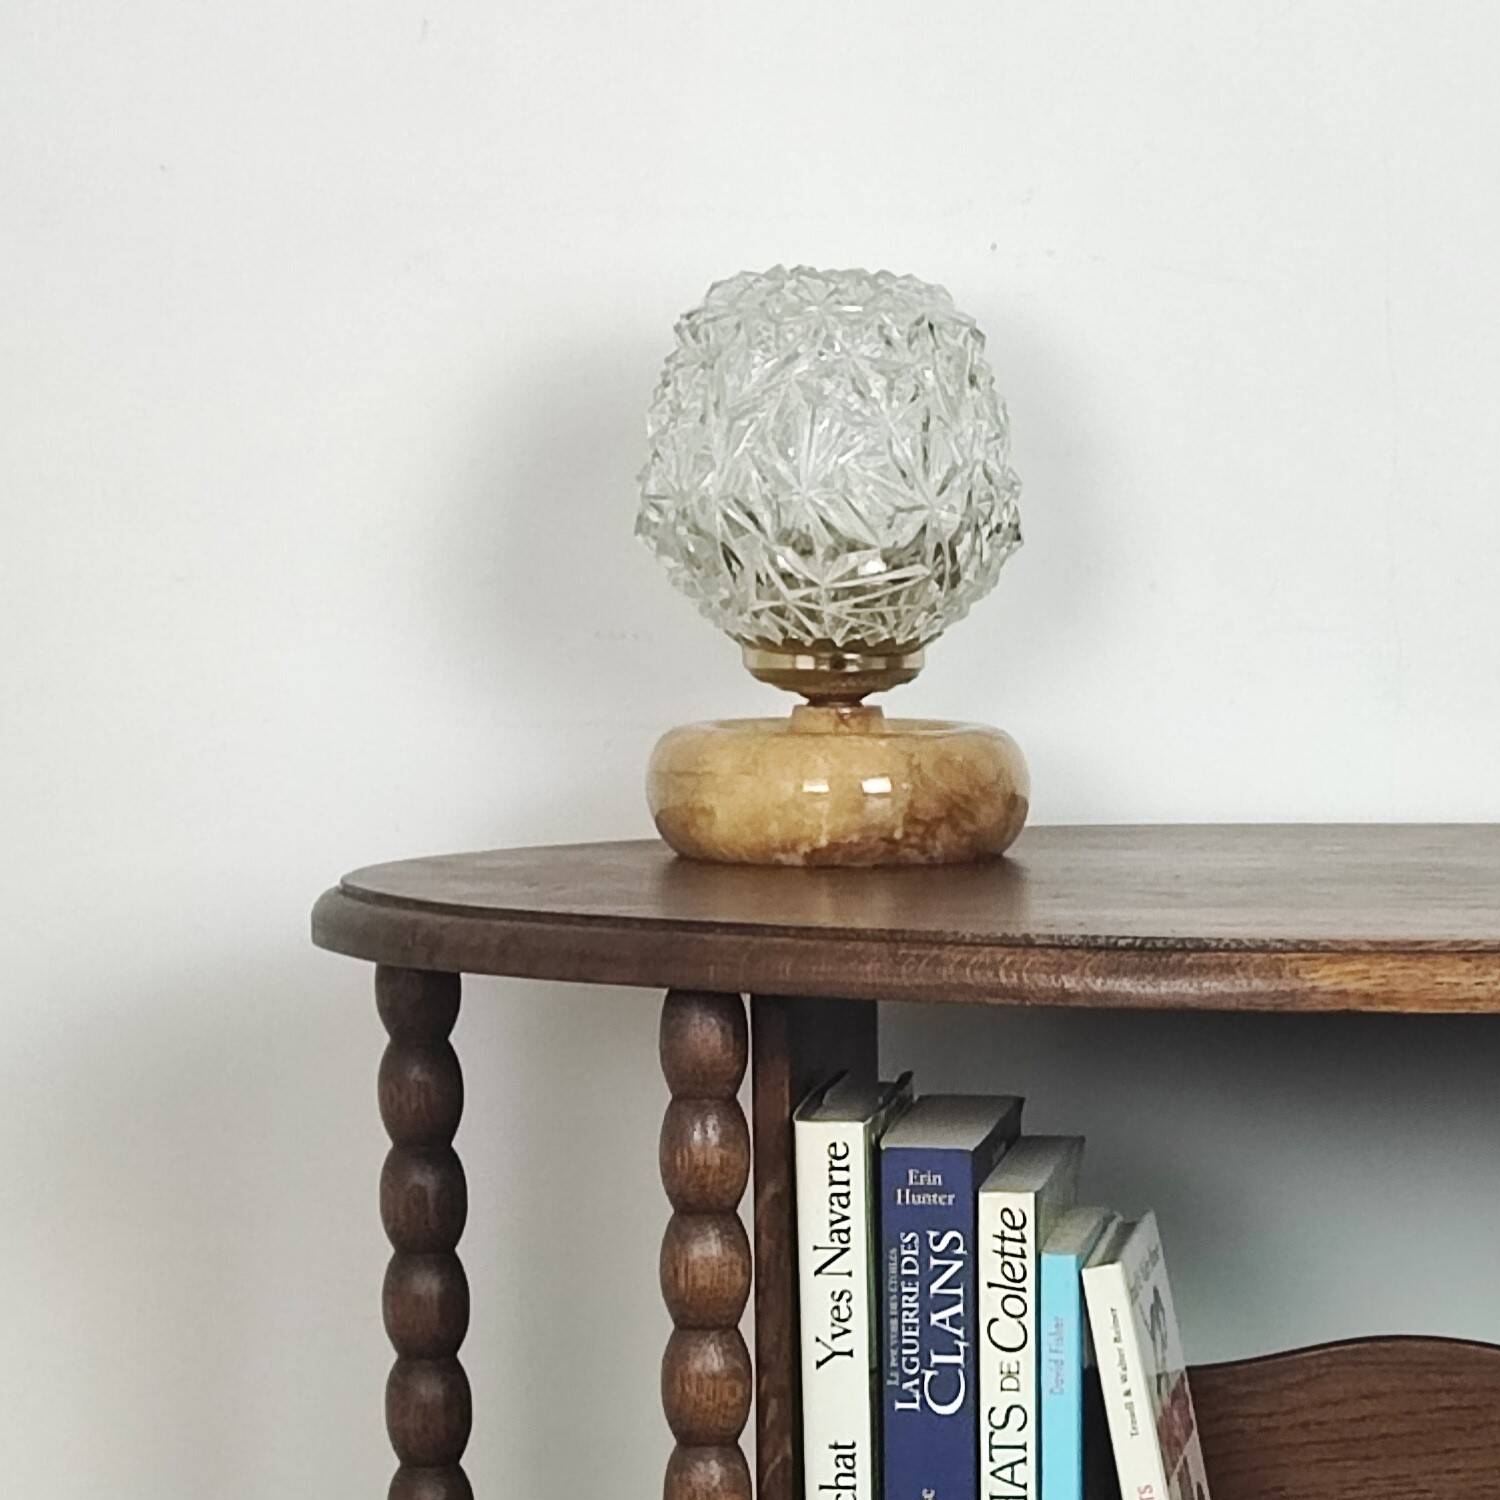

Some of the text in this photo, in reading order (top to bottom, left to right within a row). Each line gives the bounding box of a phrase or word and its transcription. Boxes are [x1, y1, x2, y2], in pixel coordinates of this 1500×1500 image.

[897, 1189, 955, 1207] Hunter
[908, 1169, 942, 1186] Erin
[814, 1141, 854, 1370] Yves Navarre
[895, 1232, 921, 1411] LA GUERRE DES
[921, 1229, 970, 1416] CLANS
[987, 1206, 1029, 1353] Colette
[1000, 1361, 1020, 1393] DE
